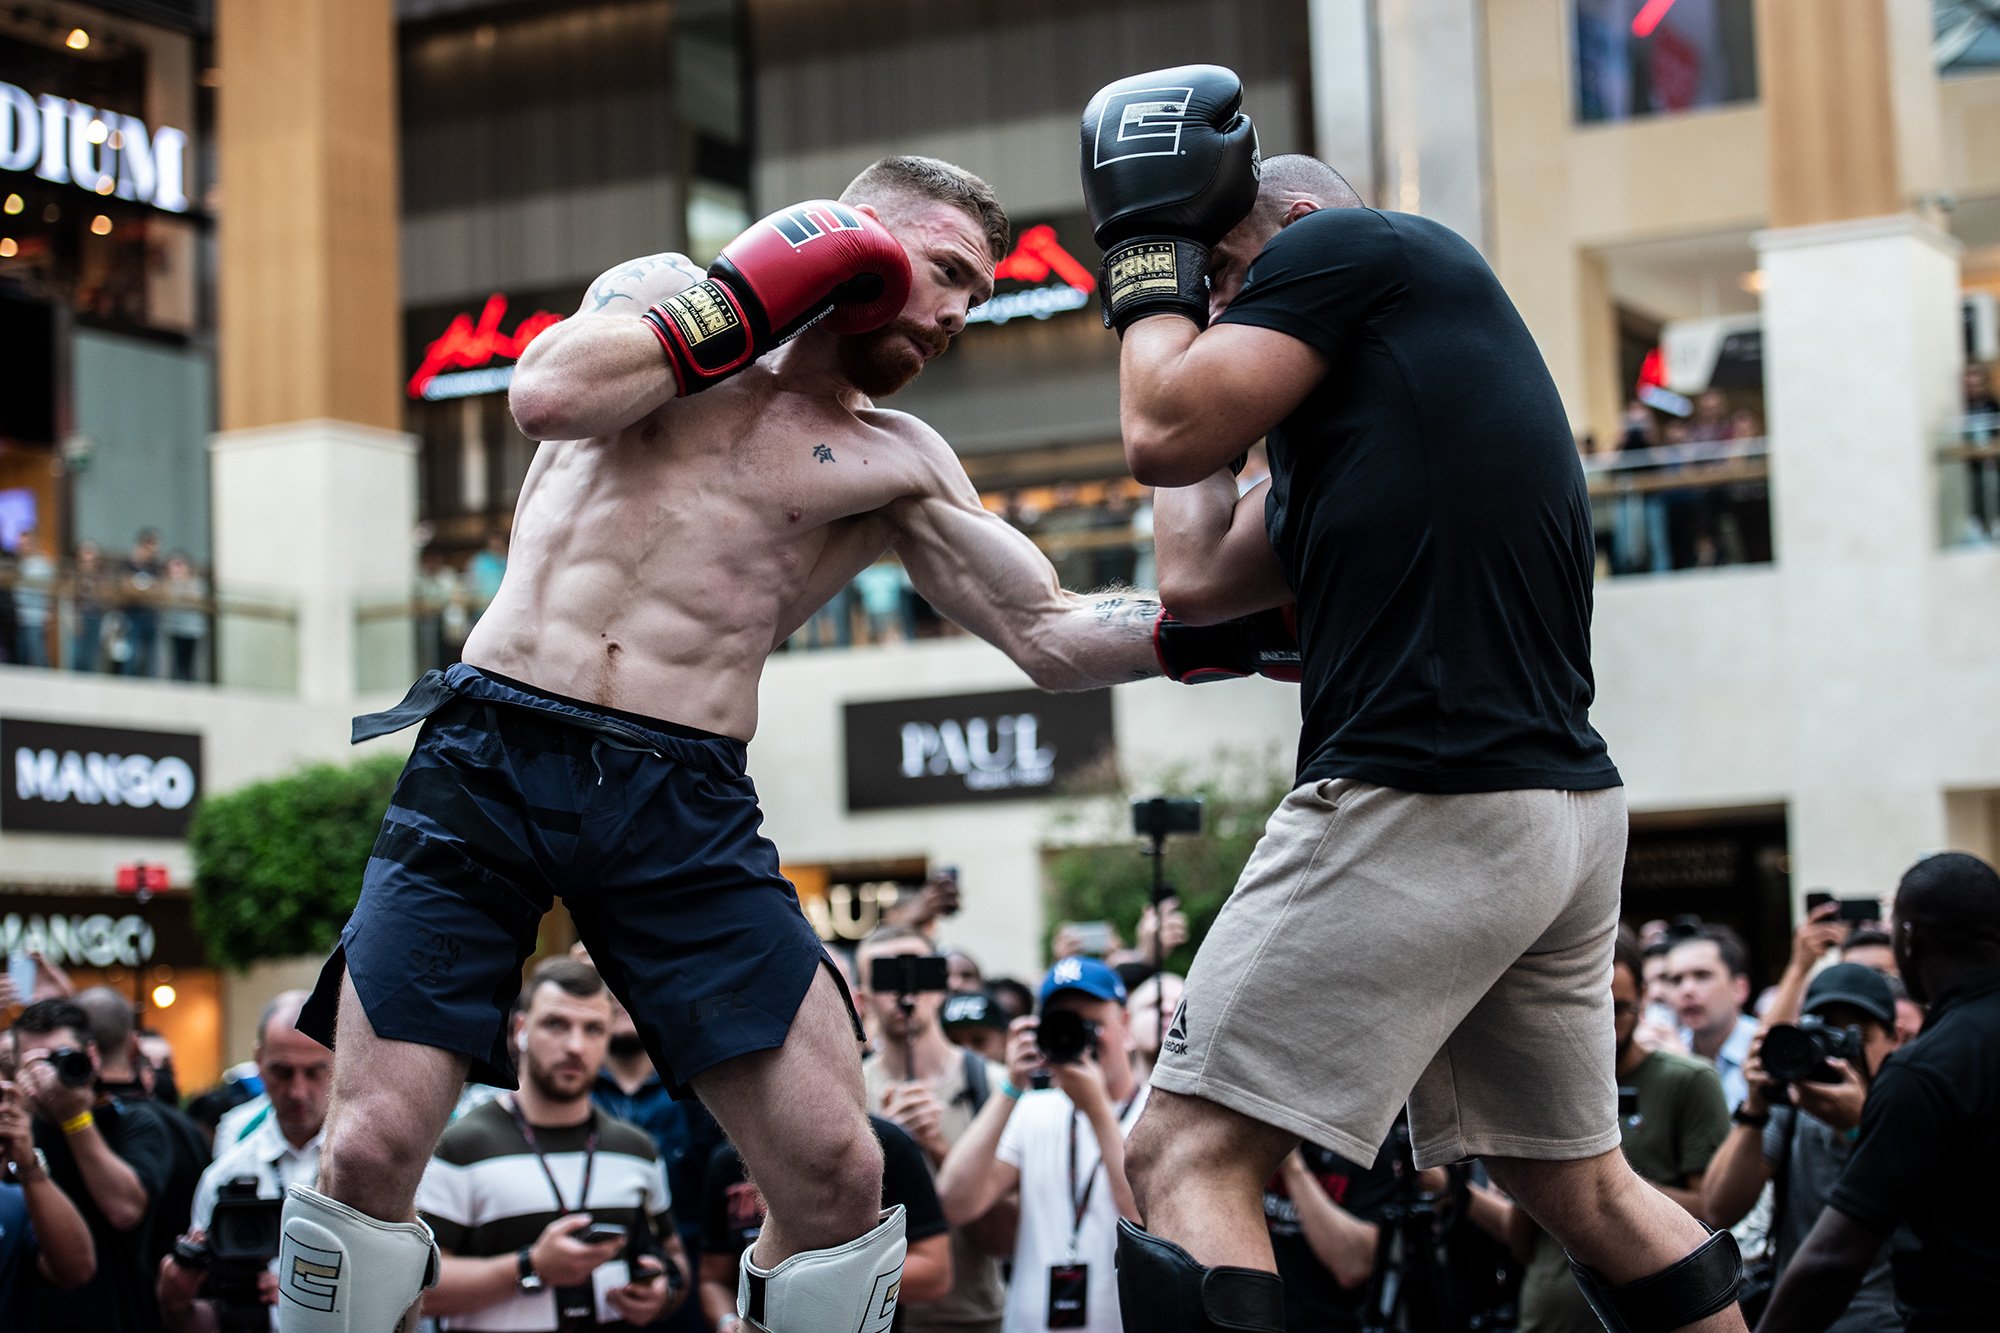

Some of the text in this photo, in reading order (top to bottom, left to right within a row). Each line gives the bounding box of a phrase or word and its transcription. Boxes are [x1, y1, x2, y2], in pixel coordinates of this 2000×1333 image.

[1111, 252, 1174, 286] CRNR
[1113, 246, 1164, 263] COMBAT
[1138, 272, 1173, 281] THAILAND
[901, 713, 1057, 778] PAUL
[15, 746, 196, 810] MANGO
